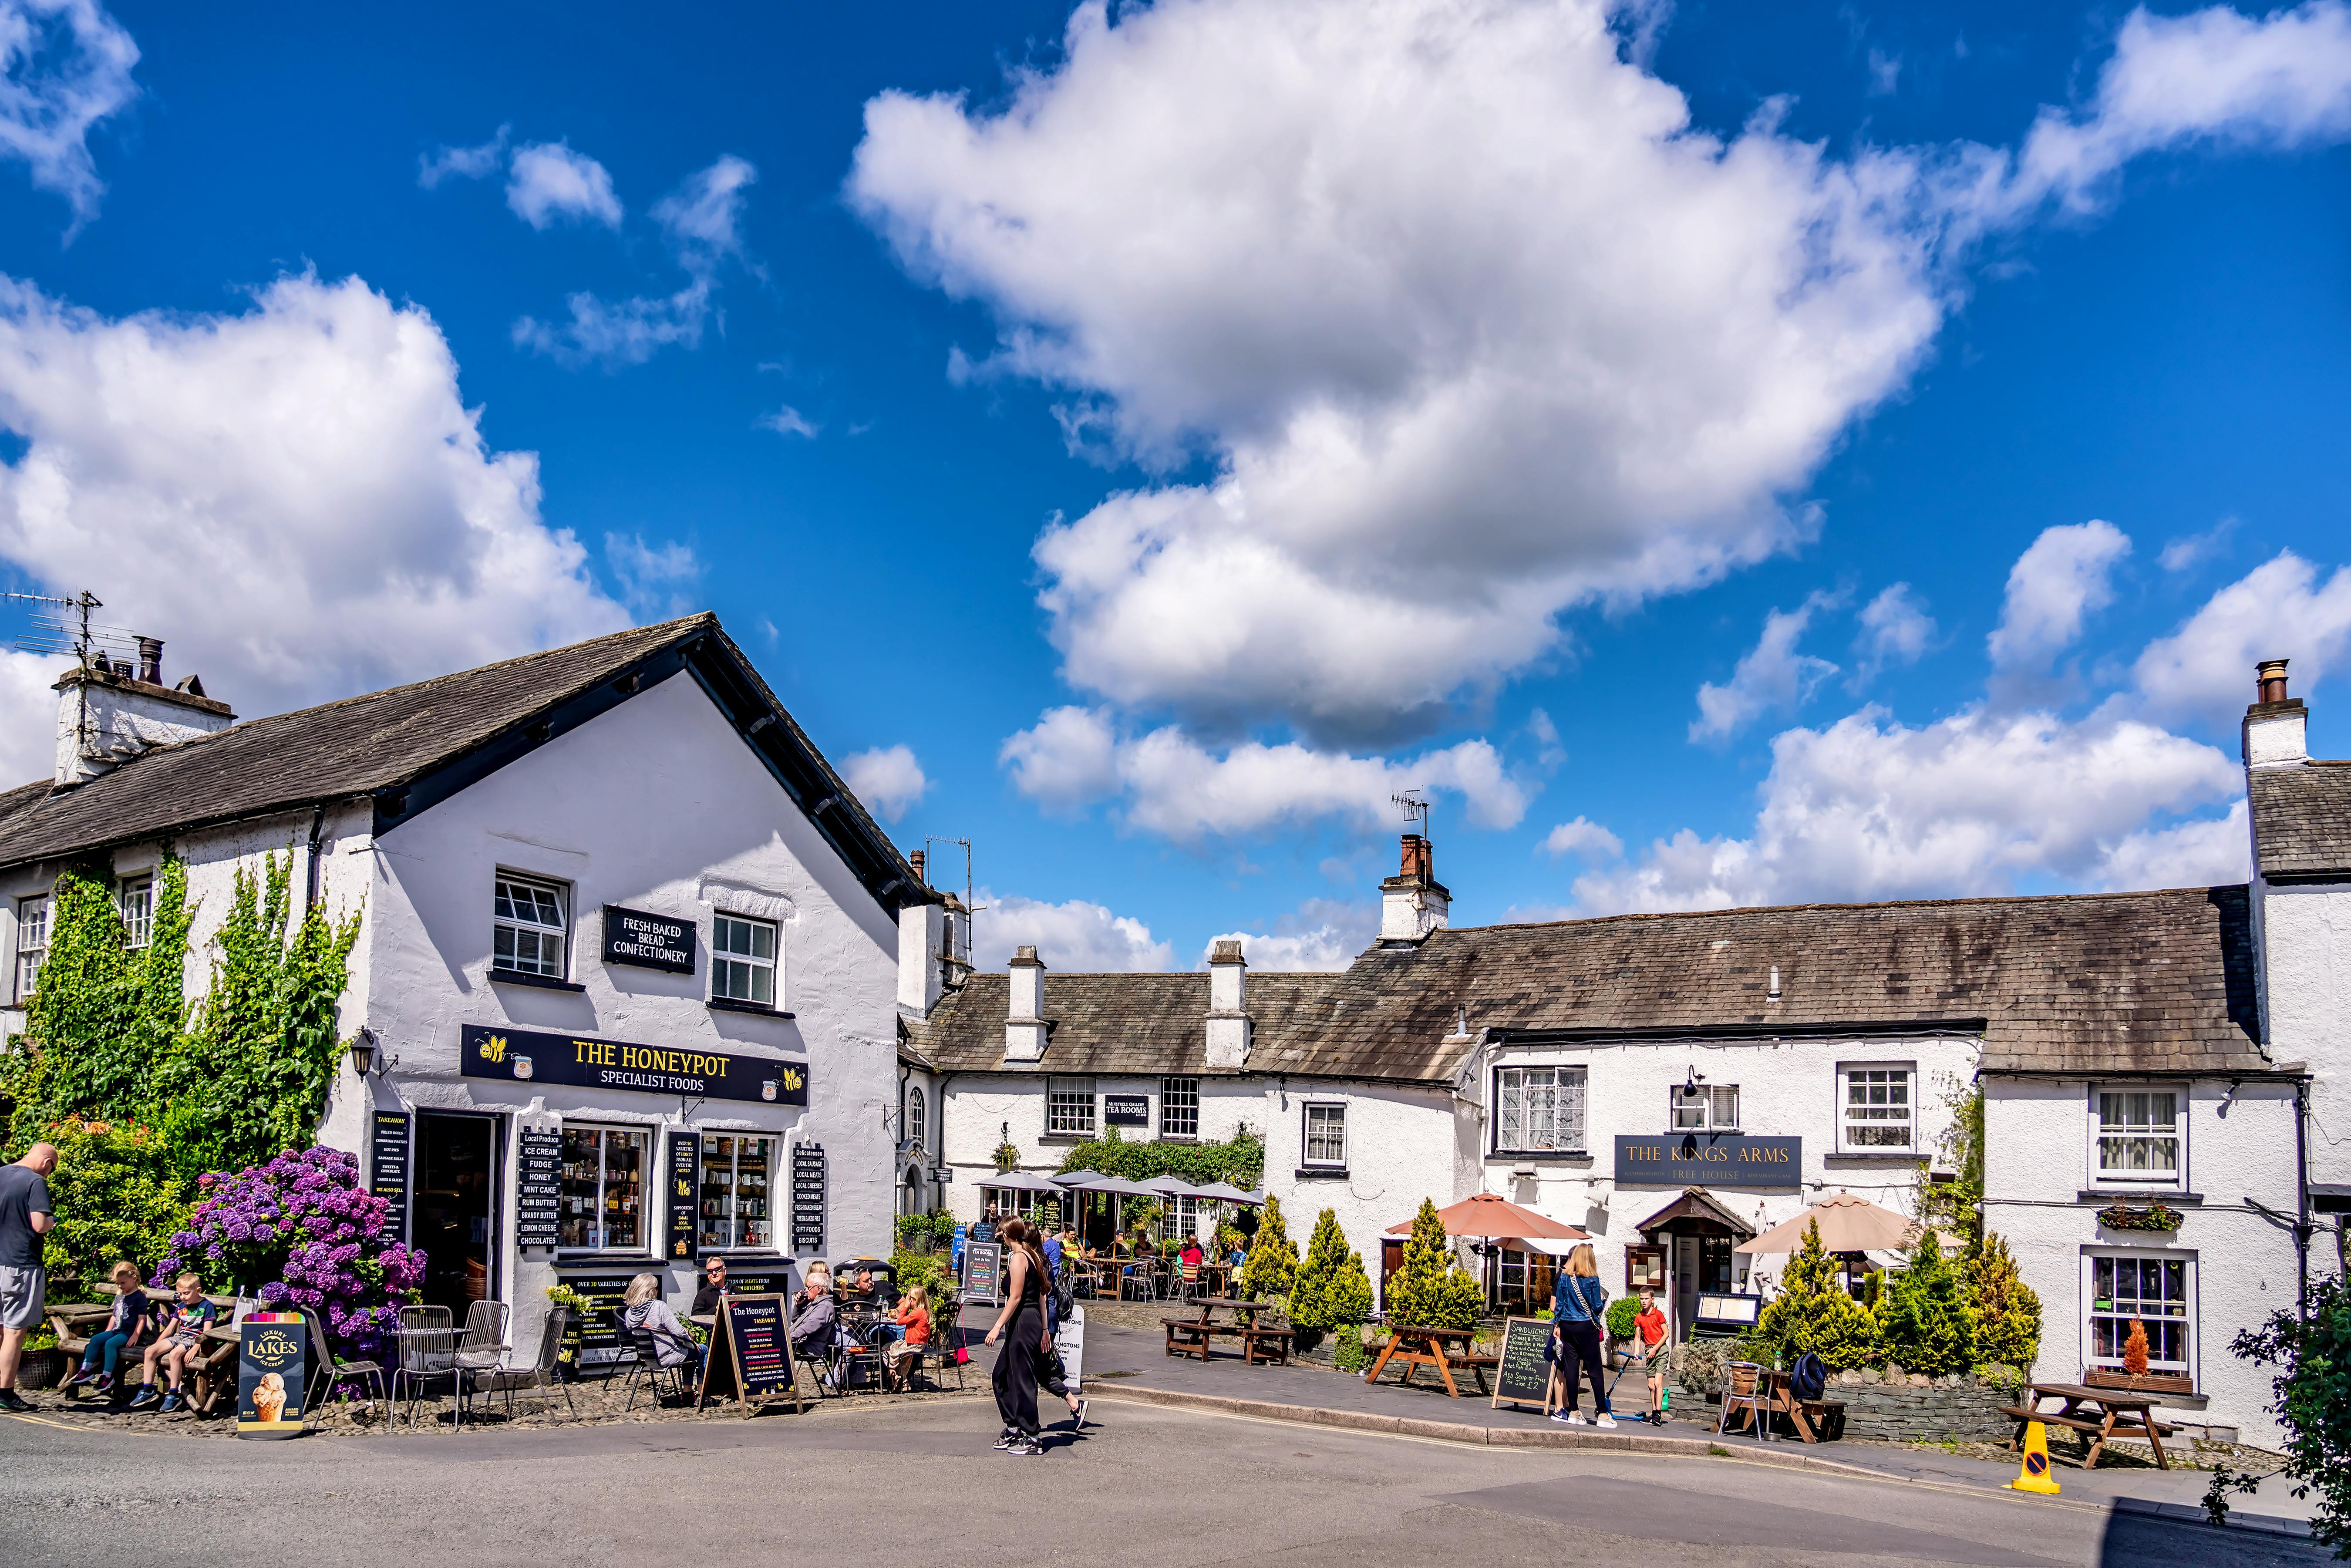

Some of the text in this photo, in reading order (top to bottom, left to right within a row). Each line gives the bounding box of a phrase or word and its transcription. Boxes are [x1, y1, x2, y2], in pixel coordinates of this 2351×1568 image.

[624, 918, 681, 937] FRESH BAKED
[639, 933, 664, 946] BREAD
[614, 941, 687, 963] CONFECTIONERY
[573, 1040, 730, 1077] THE HONEYPOT
[601, 1070, 704, 1091] SPECIALIST FOODS
[1626, 1146, 1789, 1163] THE KINGS ARMS
[1673, 1170, 1696, 1178] FREE
[1702, 1170, 1739, 1180] HOUSE
[746, 1307, 775, 1316] Honeypot
[260, 1330, 287, 1339] LUXURY
[1511, 1322, 1550, 1336] SANDWICHES
[248, 1340, 297, 1359] LAKES
[1515, 1372, 1527, 1381] Soup
[1535, 1375, 1546, 1383] Fries
[1526, 1381, 1538, 1390] £2
